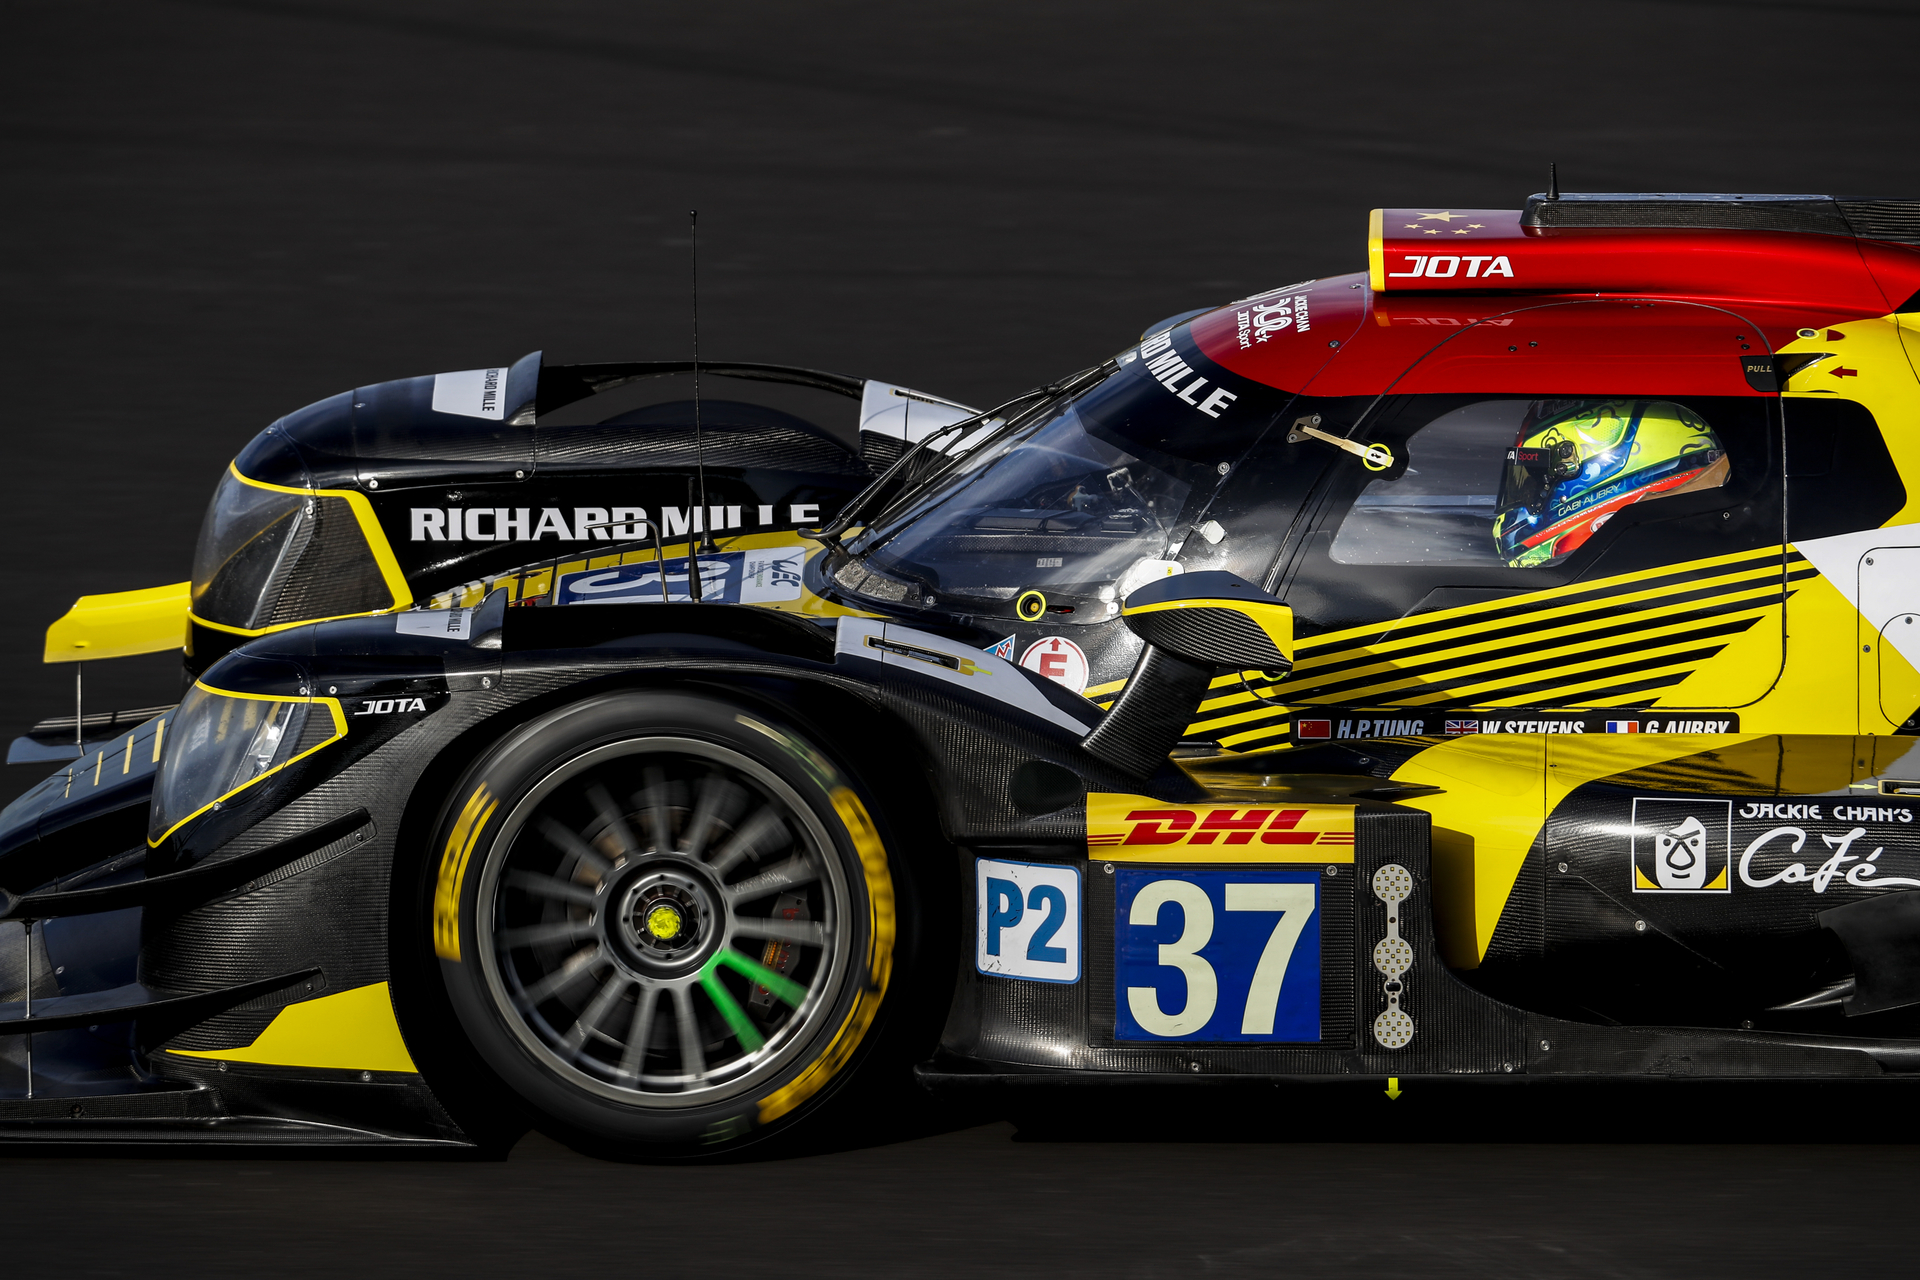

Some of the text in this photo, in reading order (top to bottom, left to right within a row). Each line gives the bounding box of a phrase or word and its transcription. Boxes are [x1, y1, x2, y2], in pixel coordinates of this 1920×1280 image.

[1389, 255, 1514, 278] JOTA
[1296, 311, 1311, 333] CHAN
[1236, 330, 1252, 350] Sport
[1746, 365, 1772, 373] PULL
[1145, 348, 1238, 419] MILLE
[482, 391, 497, 411] MILLE
[1518, 451, 1539, 462] Sport
[1557, 482, 1621, 517] GABI AUBRY
[410, 507, 647, 541] RICHARD
[354, 697, 427, 716] JOTA
[1337, 719, 1425, 739] H.P.TUNG
[1739, 802, 1823, 820] JACKIE
[1121, 809, 1321, 845] DHL
[986, 876, 1067, 963] P2
[1127, 879, 1316, 1037] 37
